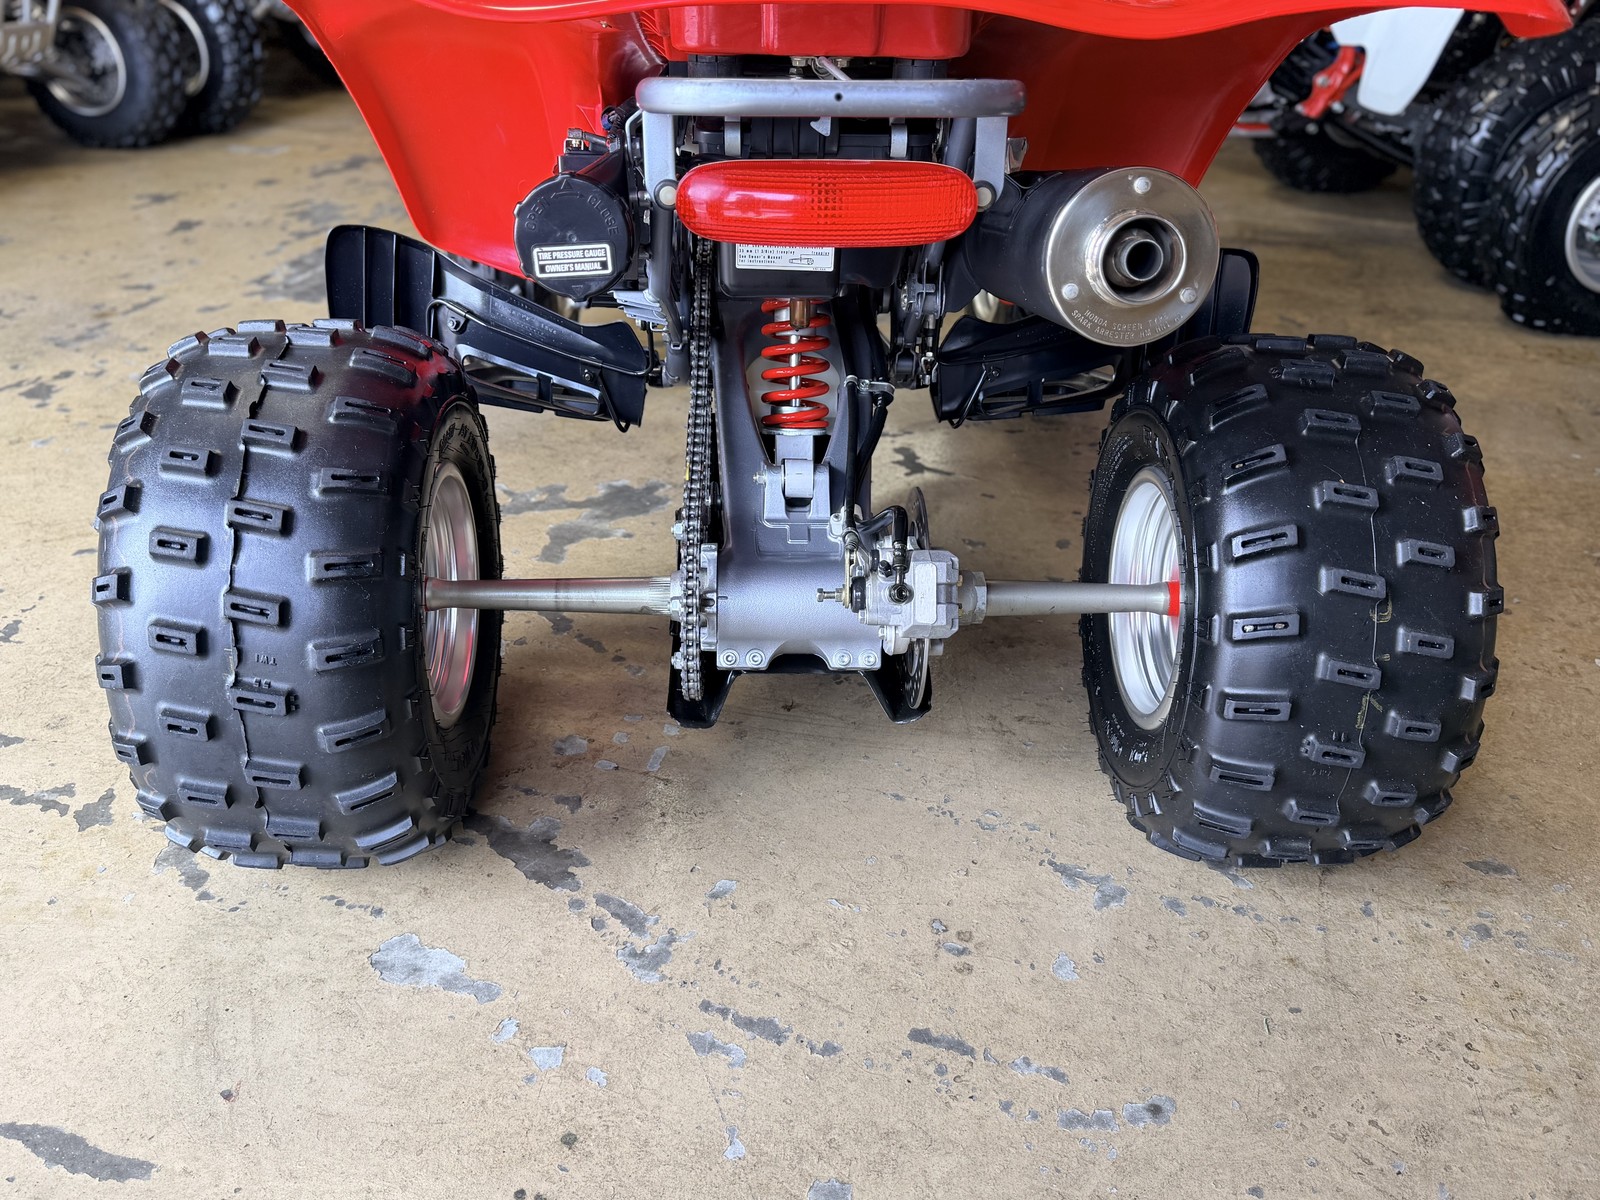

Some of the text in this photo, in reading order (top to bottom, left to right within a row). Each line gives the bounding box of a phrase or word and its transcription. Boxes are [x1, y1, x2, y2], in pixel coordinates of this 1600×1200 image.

[524, 195, 551, 231] OPEN
[586, 194, 619, 236] CLOSE
[538, 248, 606, 260] TIRE PRESSURE GAUGE
[545, 261, 602, 273] OWNER'S MANUAL
[1071, 309, 1093, 329] SPARK
[1094, 326, 1135, 340] ARRESTER
[1083, 309, 1108, 327] HONDA
[1112, 322, 1143, 332] SCREEN
